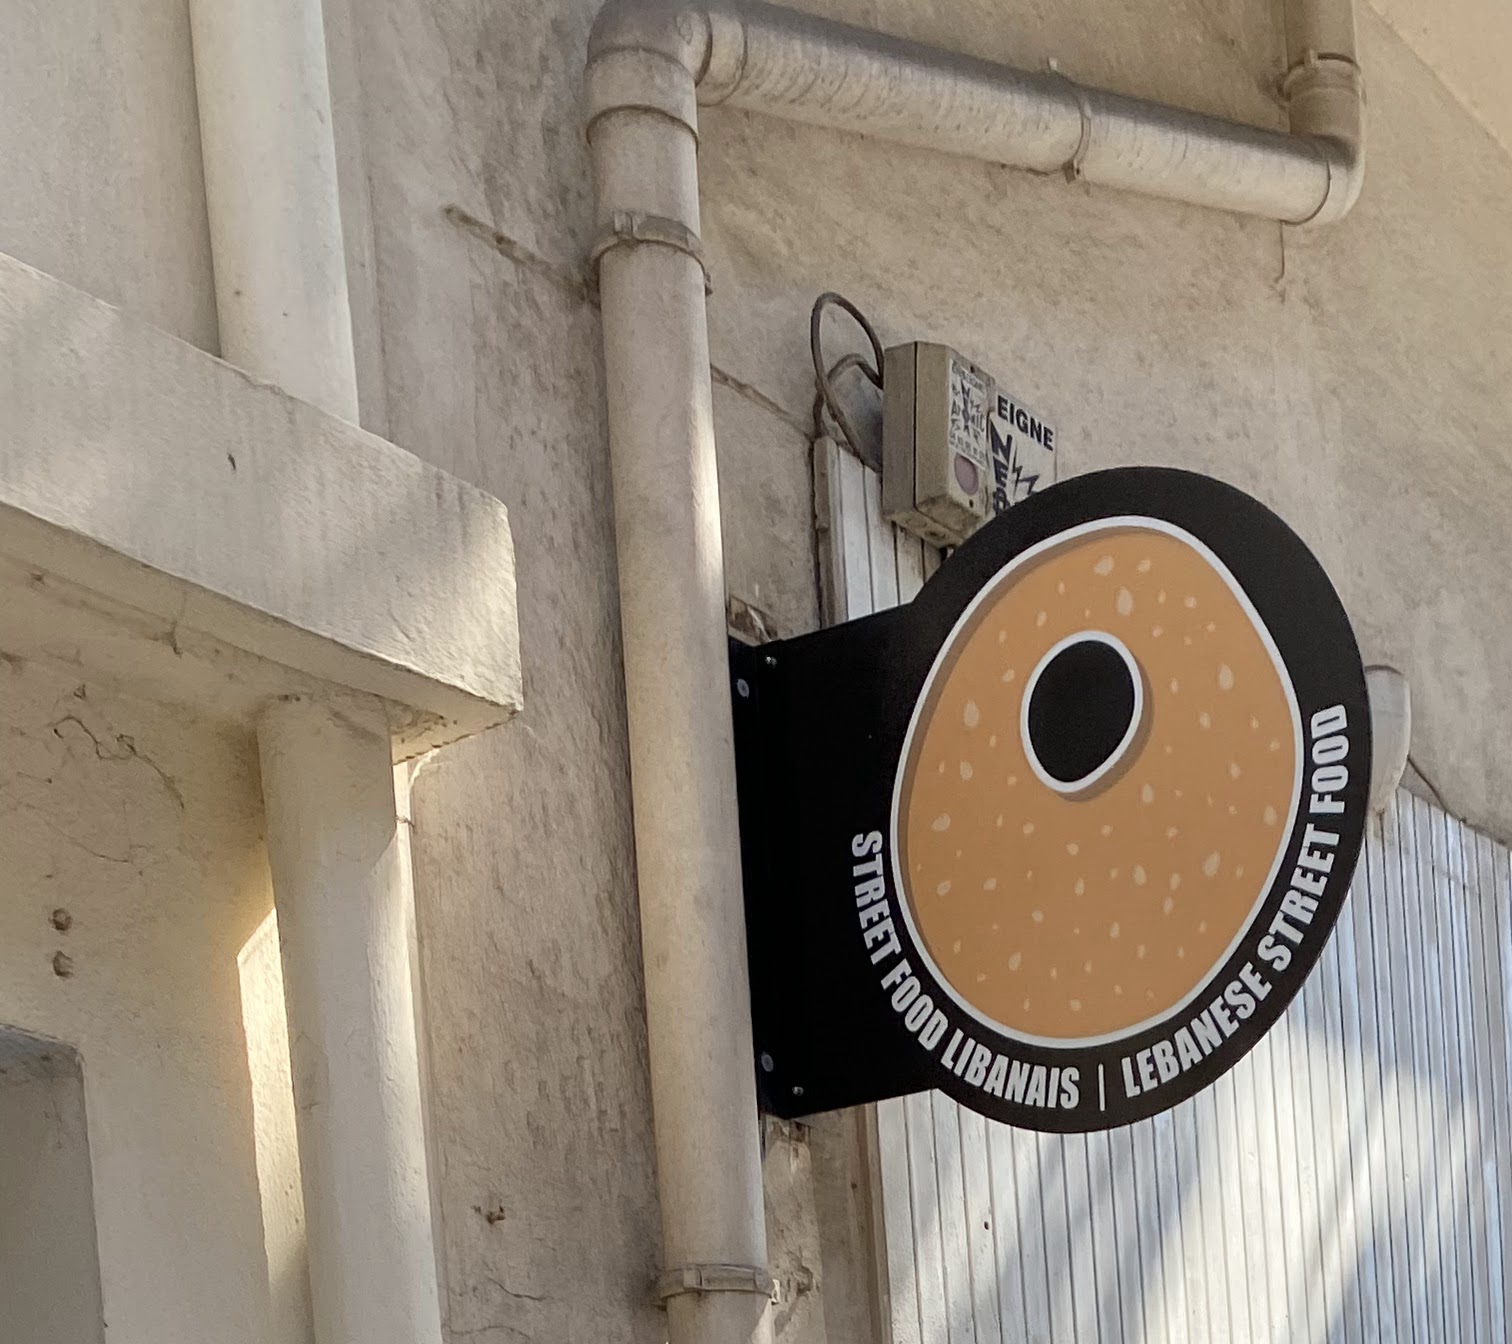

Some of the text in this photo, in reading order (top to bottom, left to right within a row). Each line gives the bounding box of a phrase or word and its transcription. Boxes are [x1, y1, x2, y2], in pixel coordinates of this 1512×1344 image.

[997, 395, 1054, 450] EIGNE
[851, 830, 901, 965] STREET
[880, 958, 948, 1051] FOOD
[940, 1028, 1080, 1109] LIBANAIS
[1121, 961, 1273, 1098] LEBANESE
[1257, 822, 1340, 972] STREET
[1309, 703, 1349, 814] FOOD
